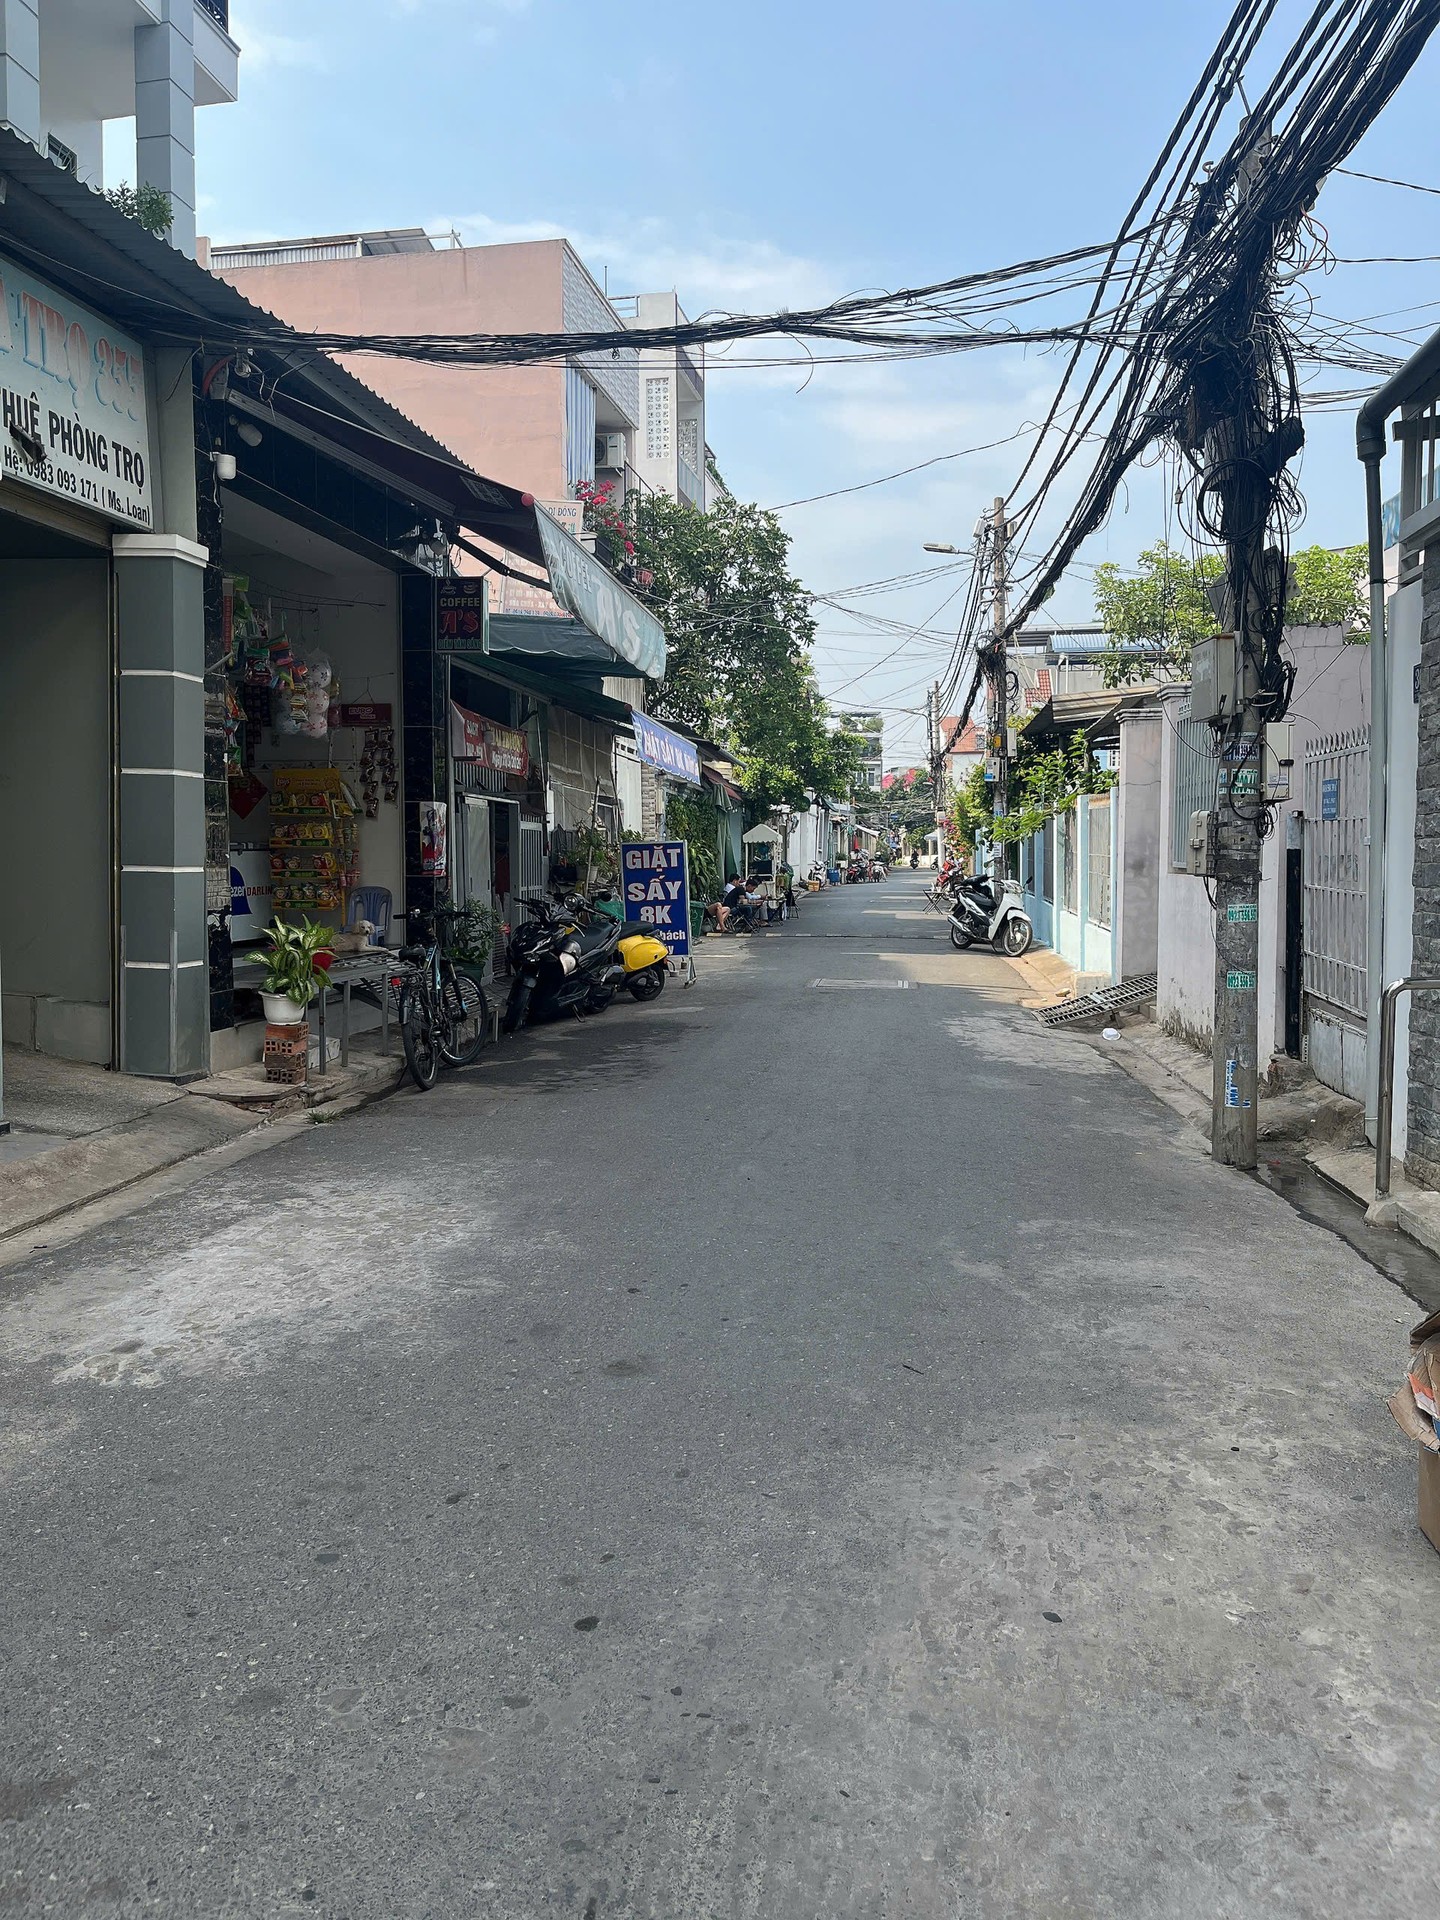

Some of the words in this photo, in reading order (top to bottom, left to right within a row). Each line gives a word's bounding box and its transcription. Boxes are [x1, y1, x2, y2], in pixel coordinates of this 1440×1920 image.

[0, 388, 41, 442] HUÊ
[48, 410, 108, 474] PHÒNG
[112, 440, 145, 495] TRỌ
[4, 445, 23, 477] Hệ:
[26, 459, 54, 485] 0983
[57, 467, 77, 494] 093
[80, 478, 98, 503] 171
[126, 496, 150, 526] Loan)
[440, 597, 480, 607] COFFEE
[439, 609, 479, 634] A'S
[625, 845, 681, 872] GIẶT
[230, 885, 245, 898] ezer
[246, 886, 273, 897] DARLIN
[627, 875, 682, 902] SẤY
[640, 904, 672, 924] 8K
[659, 929, 687, 941] hách
